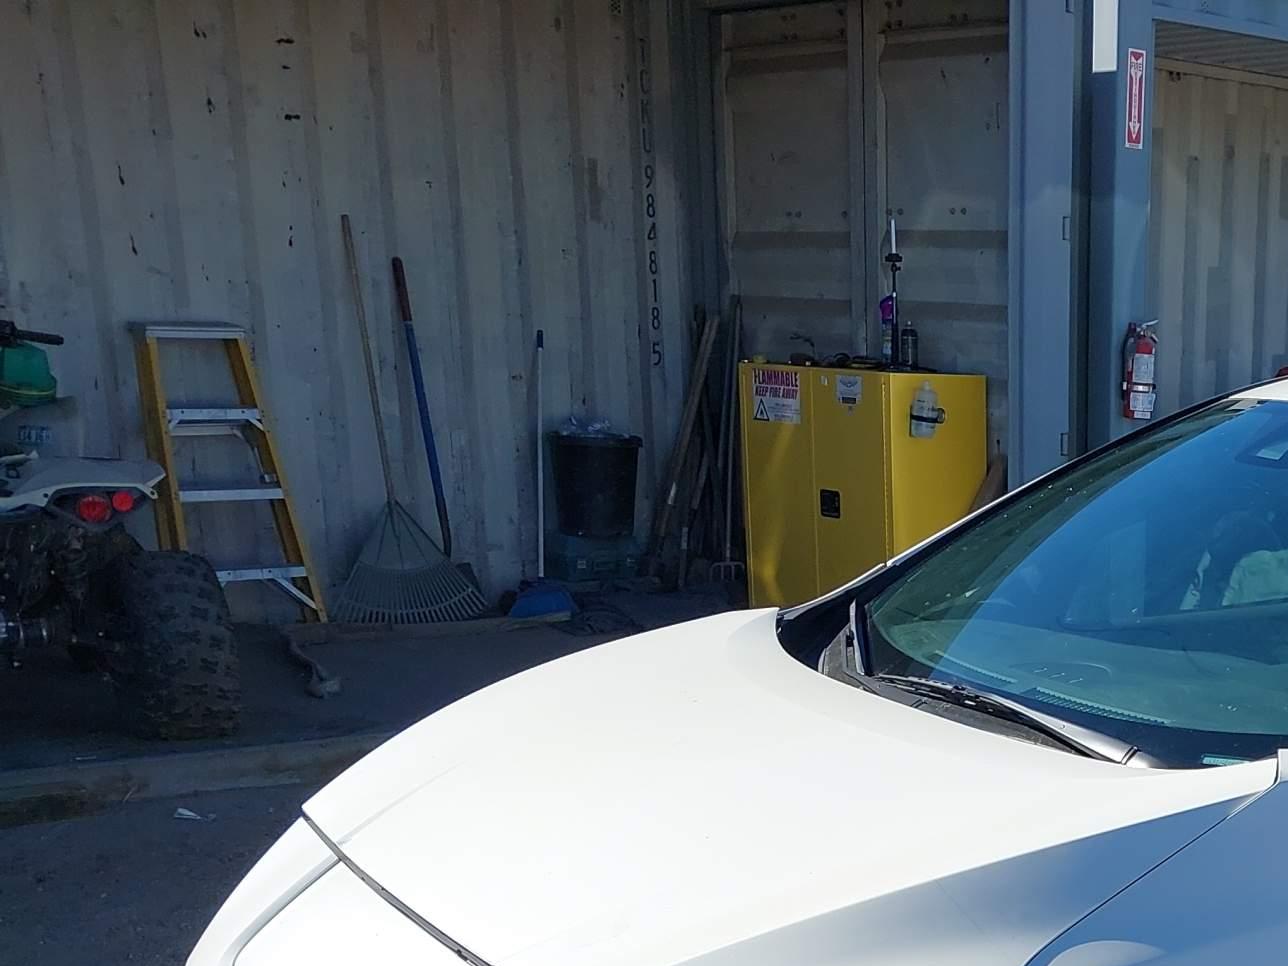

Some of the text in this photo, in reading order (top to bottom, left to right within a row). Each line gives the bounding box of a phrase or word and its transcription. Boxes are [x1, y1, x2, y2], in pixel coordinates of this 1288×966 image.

[753, 368, 798, 387] FLAMMABLE
[755, 386, 798, 400] KEEP FIRE AWAY
